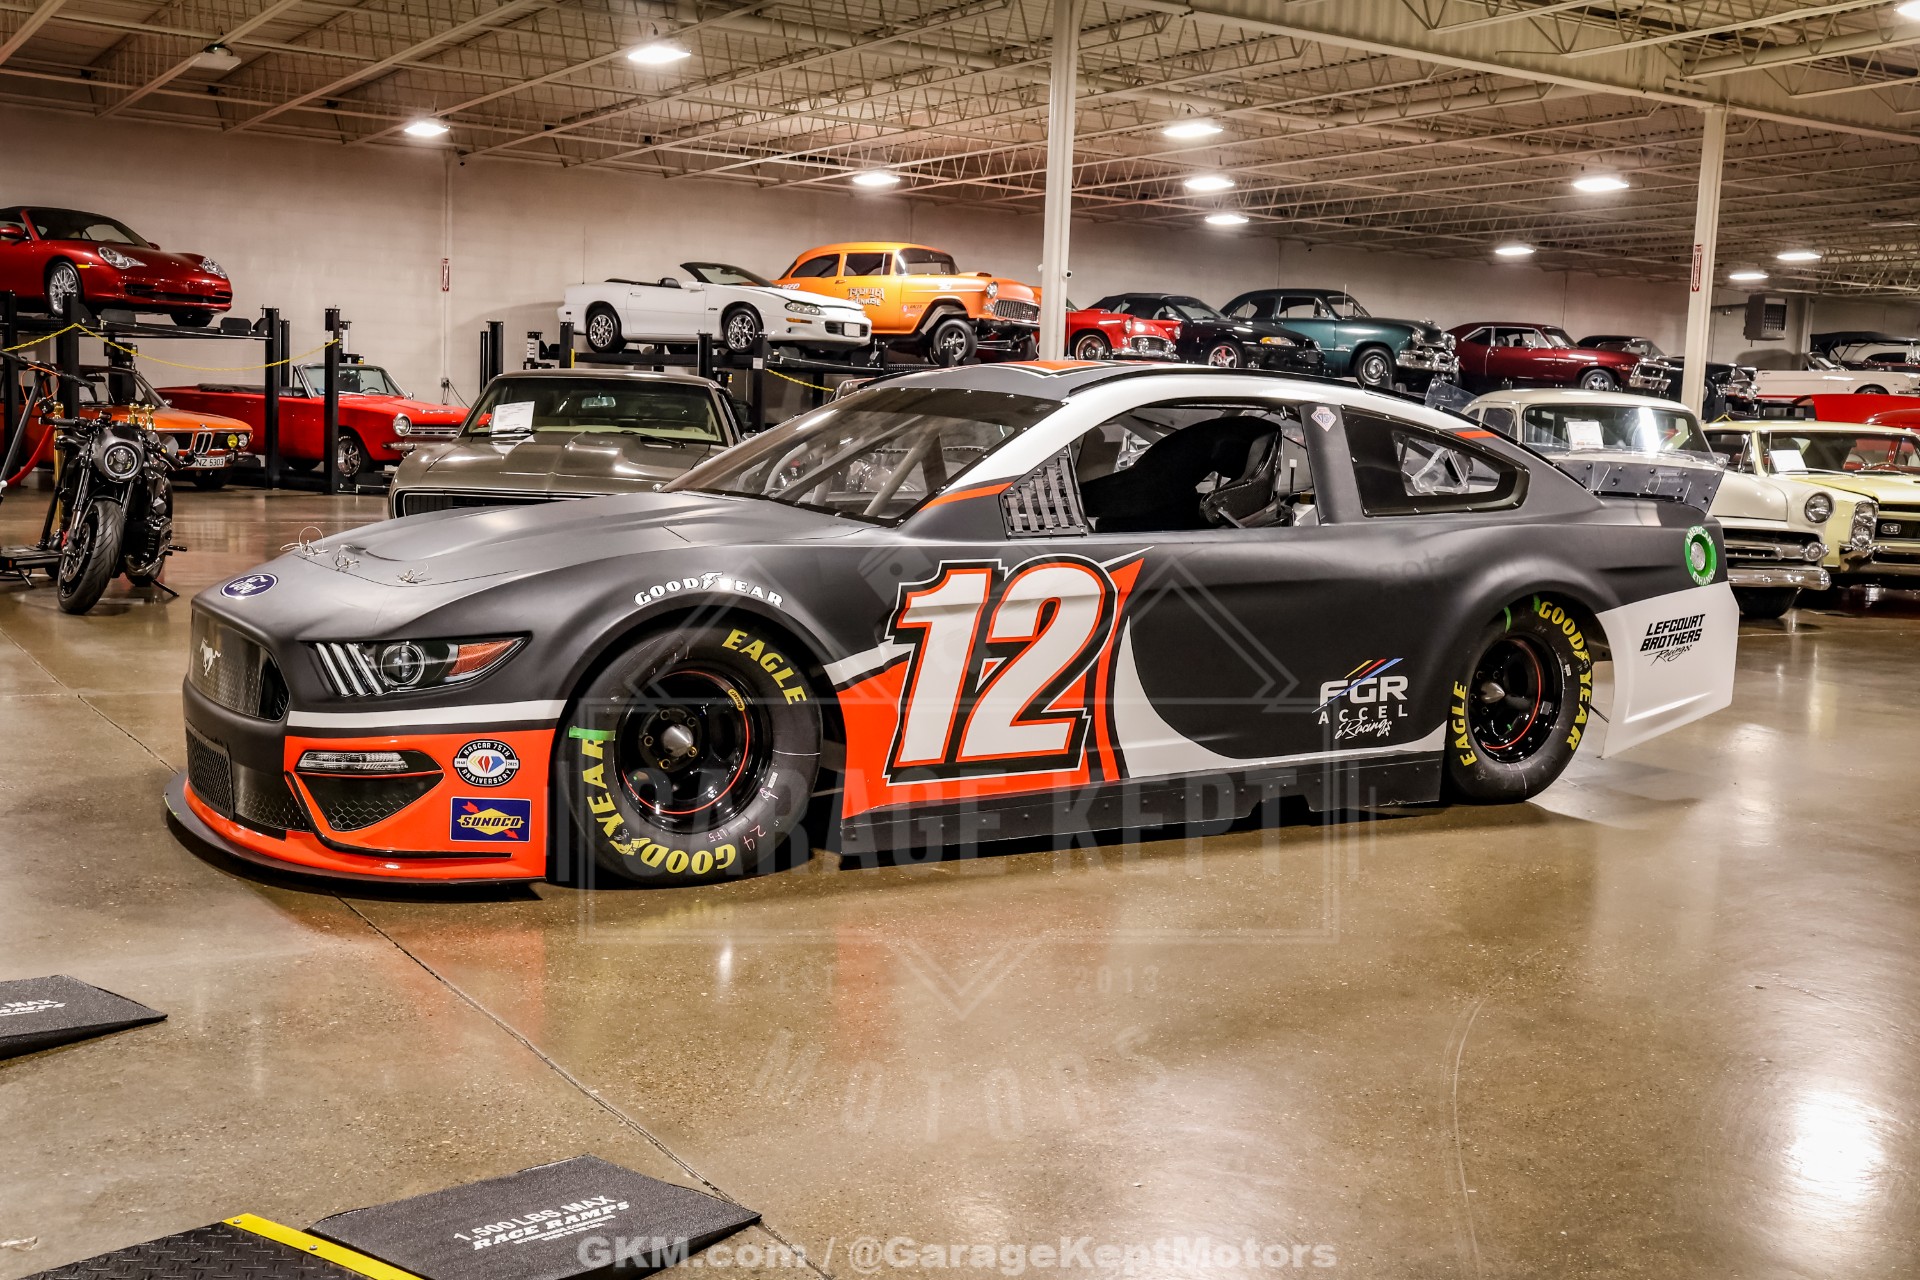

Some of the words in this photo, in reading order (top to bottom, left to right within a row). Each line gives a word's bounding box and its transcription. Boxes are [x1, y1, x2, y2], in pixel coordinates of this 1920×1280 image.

[1686, 526, 1714, 547] AMERICAN
[634, 571, 784, 608] GOODYEAR
[1692, 569, 1716, 586] ETHANOL
[1646, 614, 1706, 637] LEFCOURT
[1640, 628, 1703, 652] BROTHERS
[722, 628, 807, 705] EAGLE
[885, 555, 1116, 785] 12
[1539, 601, 1593, 751] GOODYEAR
[1320, 676, 1408, 707] FGR
[1318, 704, 1408, 725] ACCEL
[1451, 680, 1478, 767] EAGLE
[463, 742, 491, 756] NASCAR
[493, 743, 511, 757] 75TH
[461, 769, 512, 785] ANNIVERSARY
[581, 738, 736, 875] GOODYEAR
[461, 817, 521, 827] SUNOCO
[453, 1221, 517, 1241] 1,500
[472, 1225, 540, 1250] RACE
[546, 1201, 630, 1230] RAMPS
